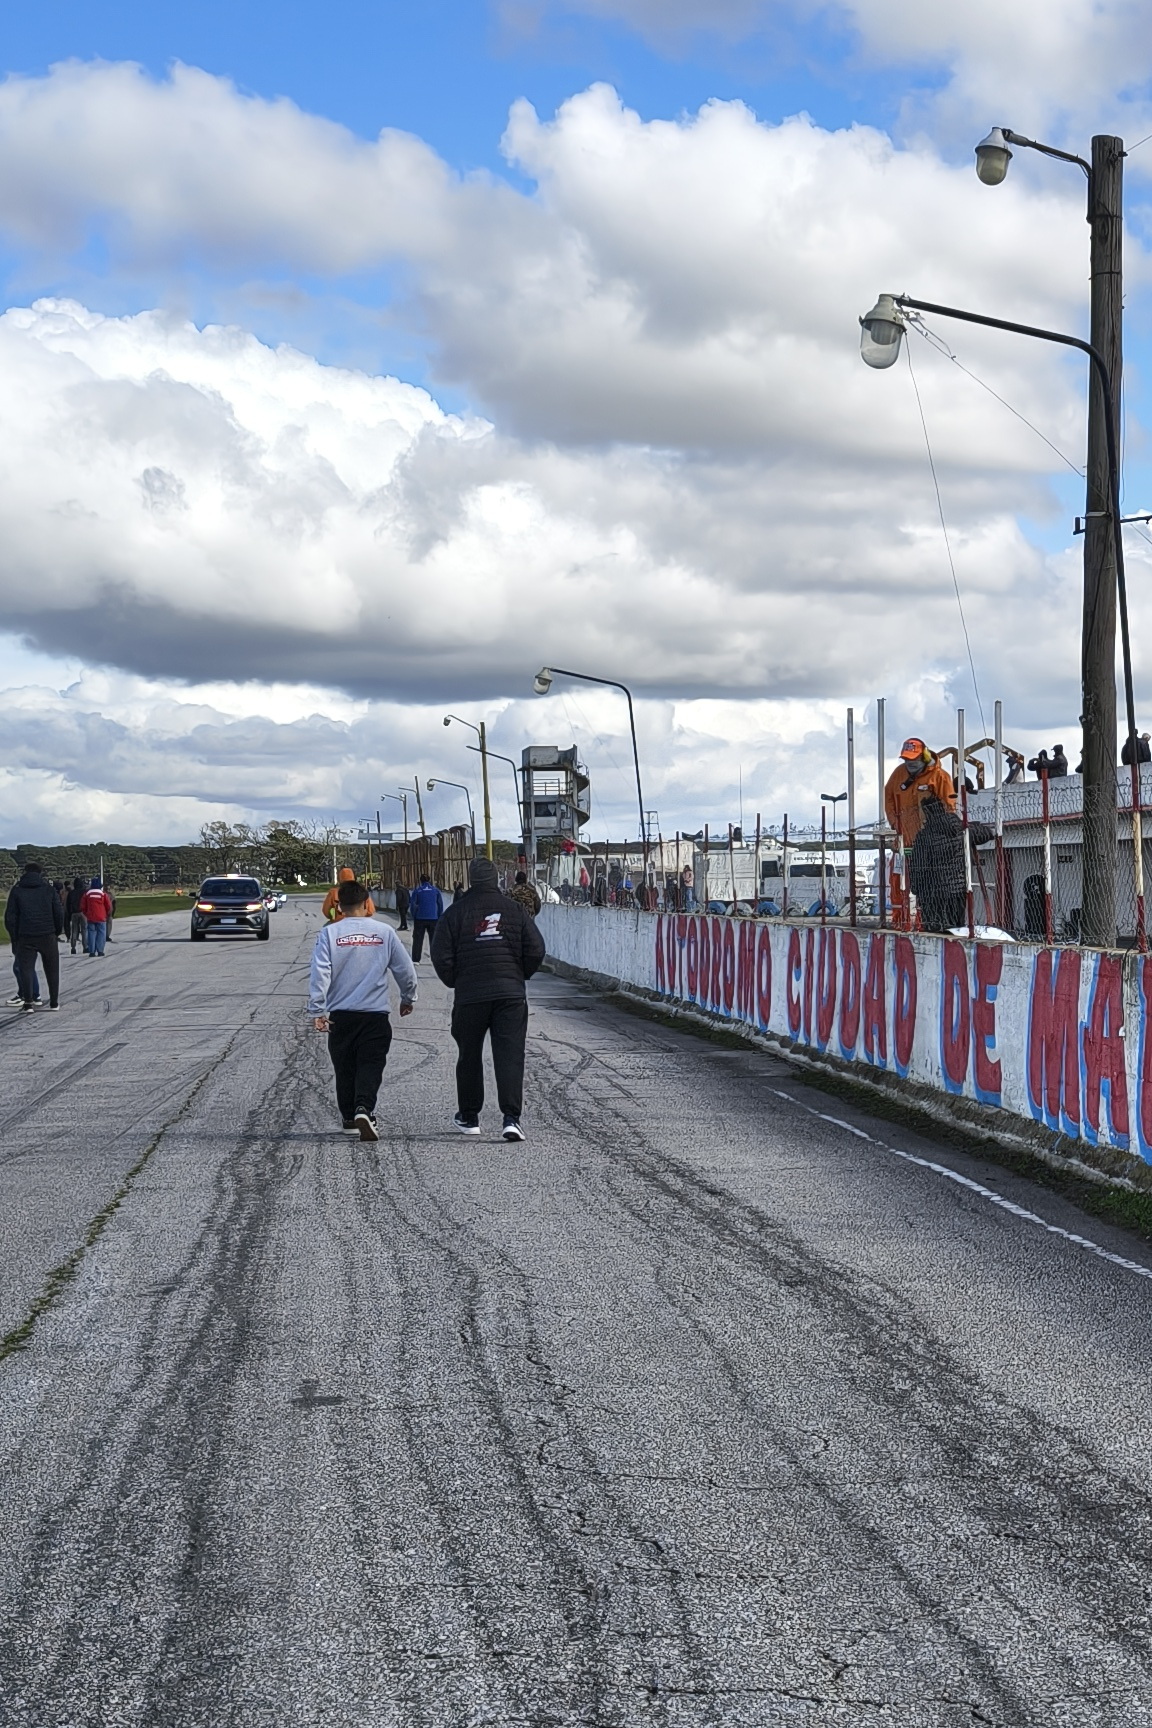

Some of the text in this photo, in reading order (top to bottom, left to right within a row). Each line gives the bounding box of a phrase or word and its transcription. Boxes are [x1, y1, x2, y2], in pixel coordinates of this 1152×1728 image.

[655, 914, 773, 1033] AUTODROMO
[786, 926, 918, 1079] CIUDAD
[940, 938, 1003, 1108] DE
